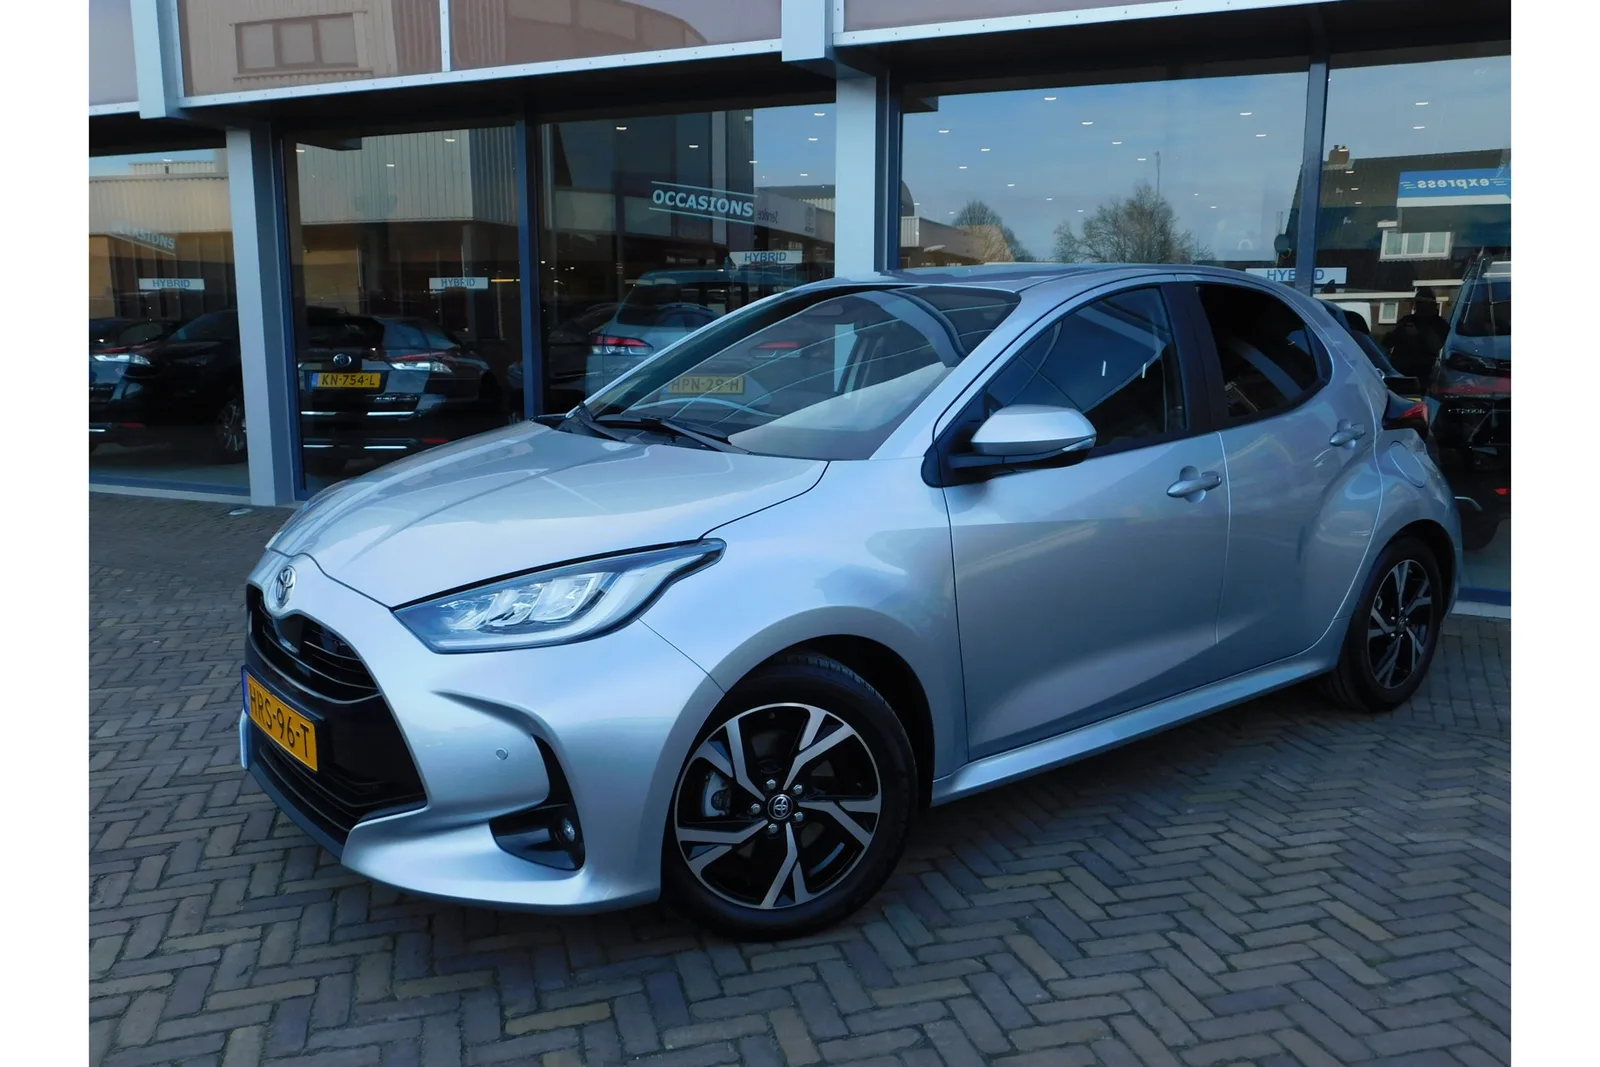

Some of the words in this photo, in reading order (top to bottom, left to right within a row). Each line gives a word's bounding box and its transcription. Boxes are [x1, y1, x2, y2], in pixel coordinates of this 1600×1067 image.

[652, 189, 754, 217] OCCASIONS
[744, 252, 787, 262] HYBRID
[1267, 269, 1325, 281] HYBD
[152, 279, 191, 288] HYBRID
[440, 278, 476, 287] HYBRID
[321, 374, 376, 387] KN-754-L
[248, 683, 310, 758] HRS-96-T
